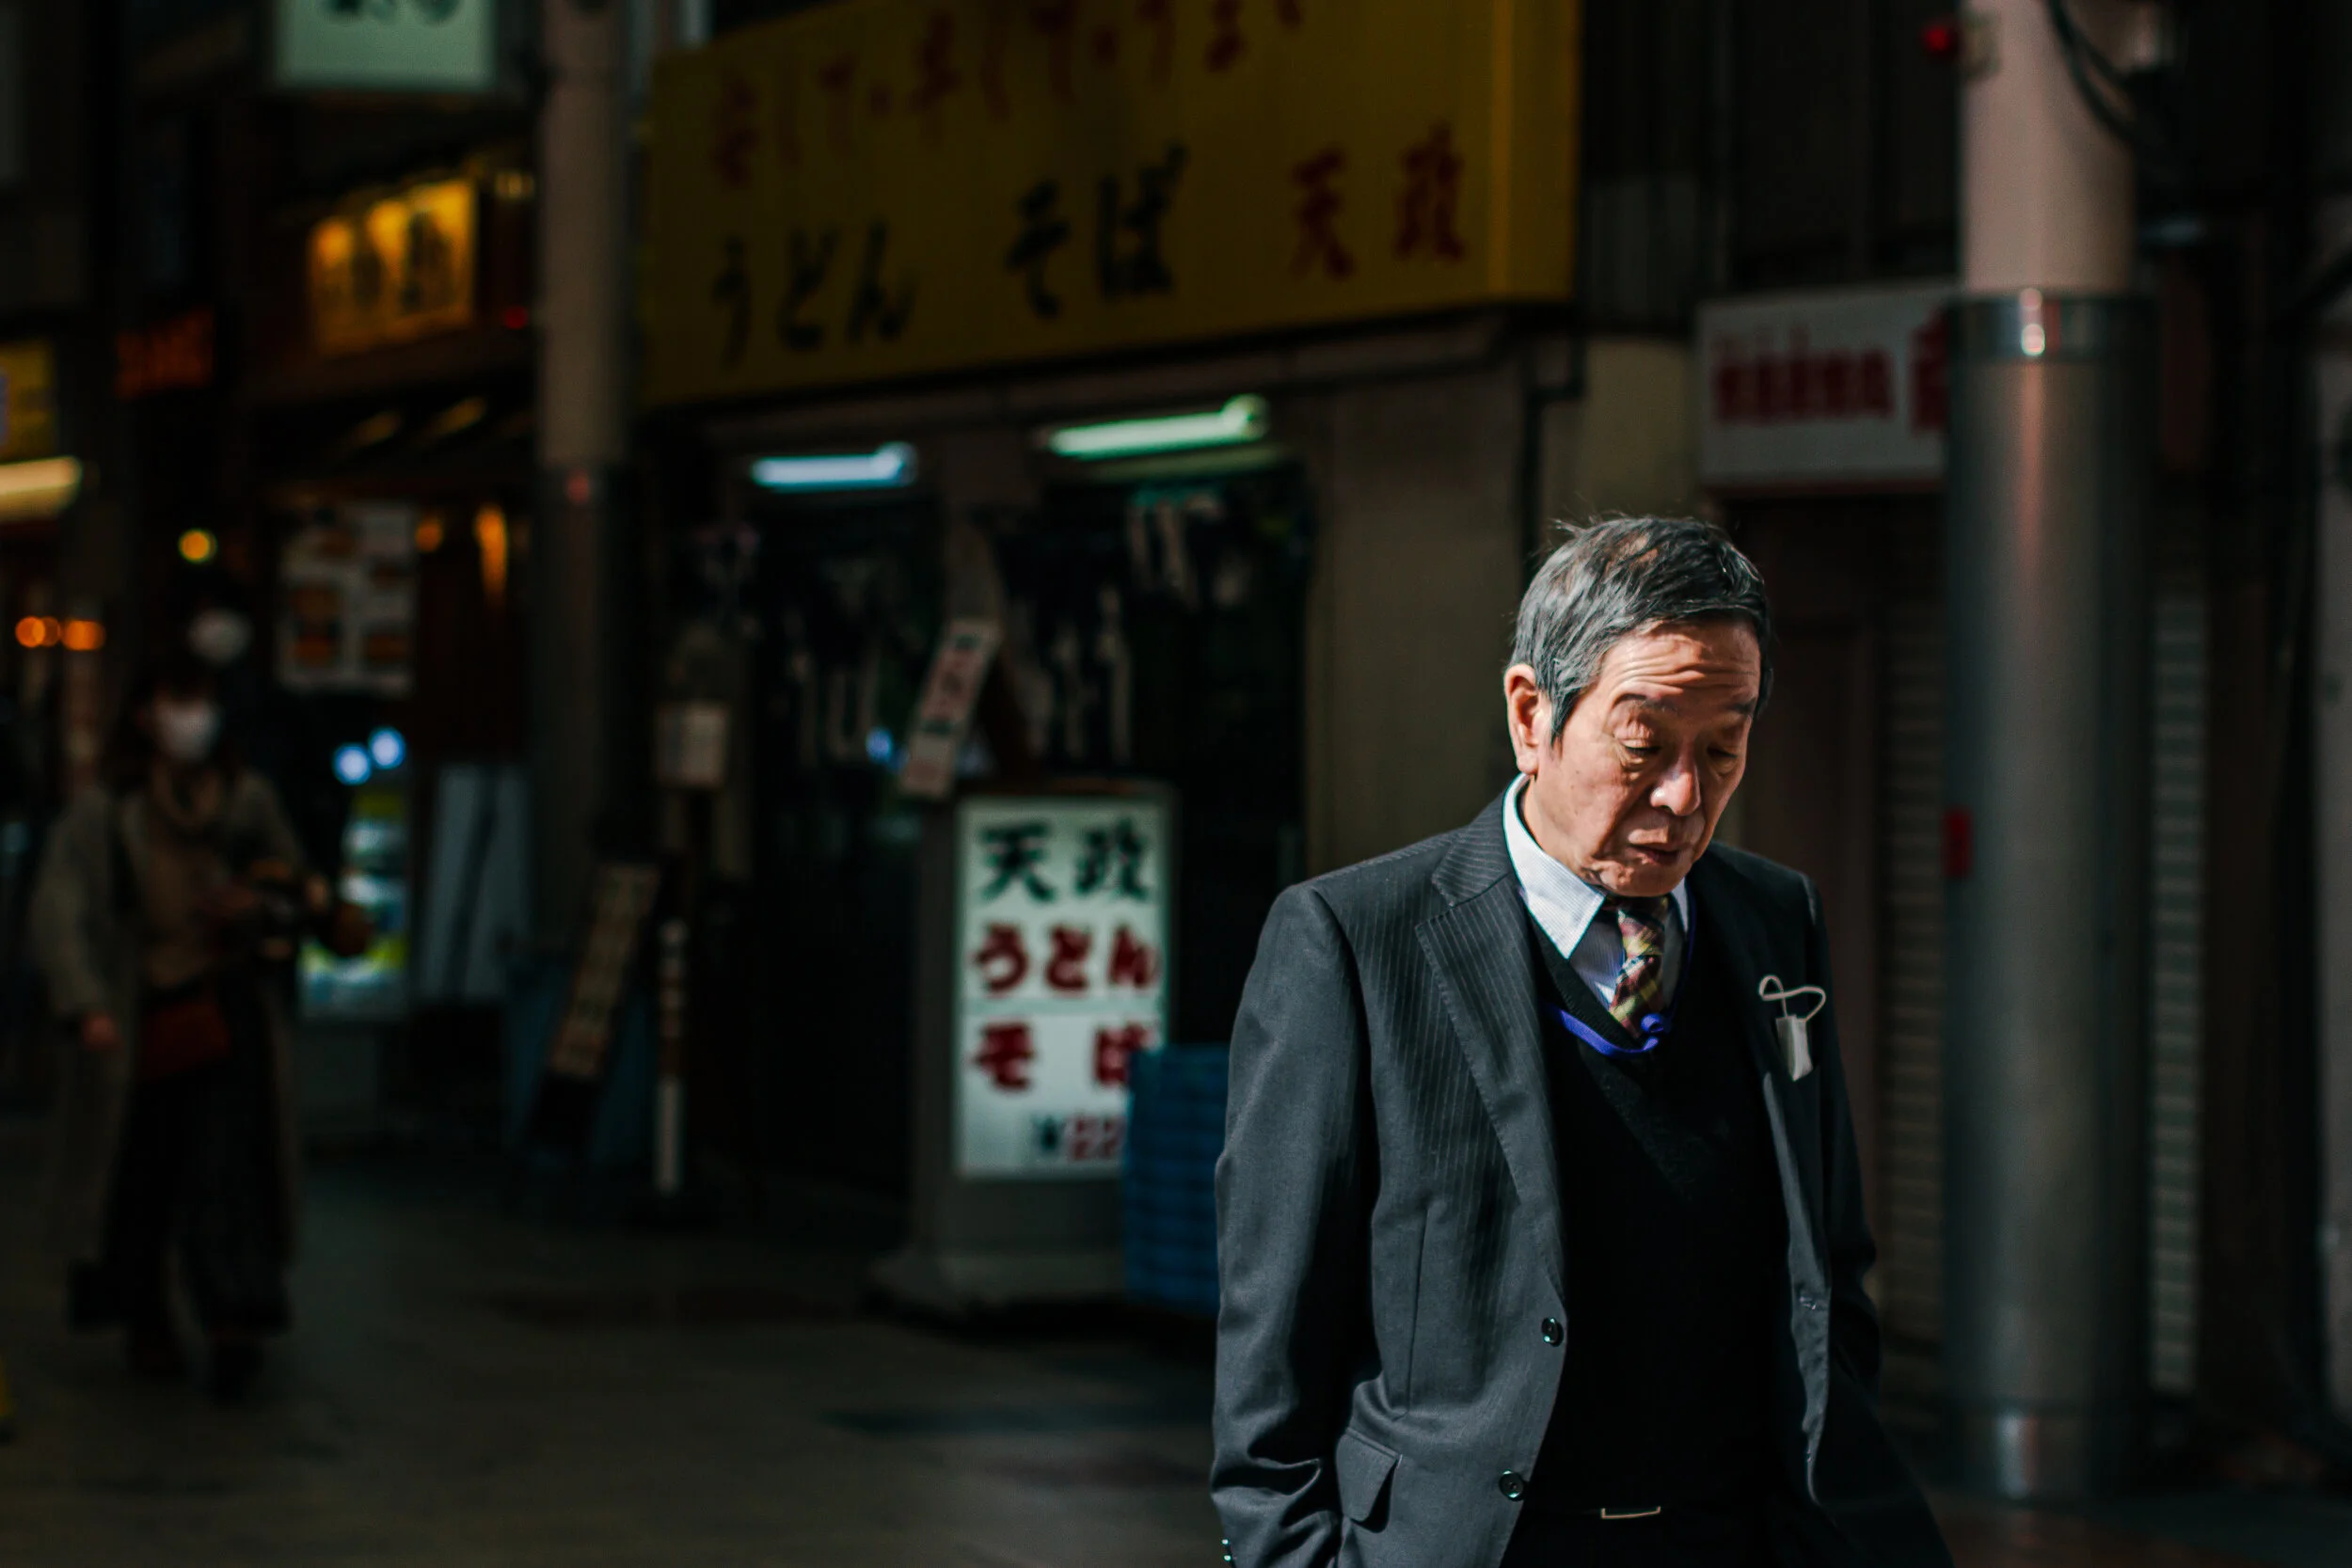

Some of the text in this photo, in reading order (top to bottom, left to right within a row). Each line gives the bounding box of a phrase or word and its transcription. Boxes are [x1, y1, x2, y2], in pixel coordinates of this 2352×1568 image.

[712, 219, 918, 365] うどん
[1003, 141, 1187, 319] そば
[974, 924, 1159, 993] うどん
